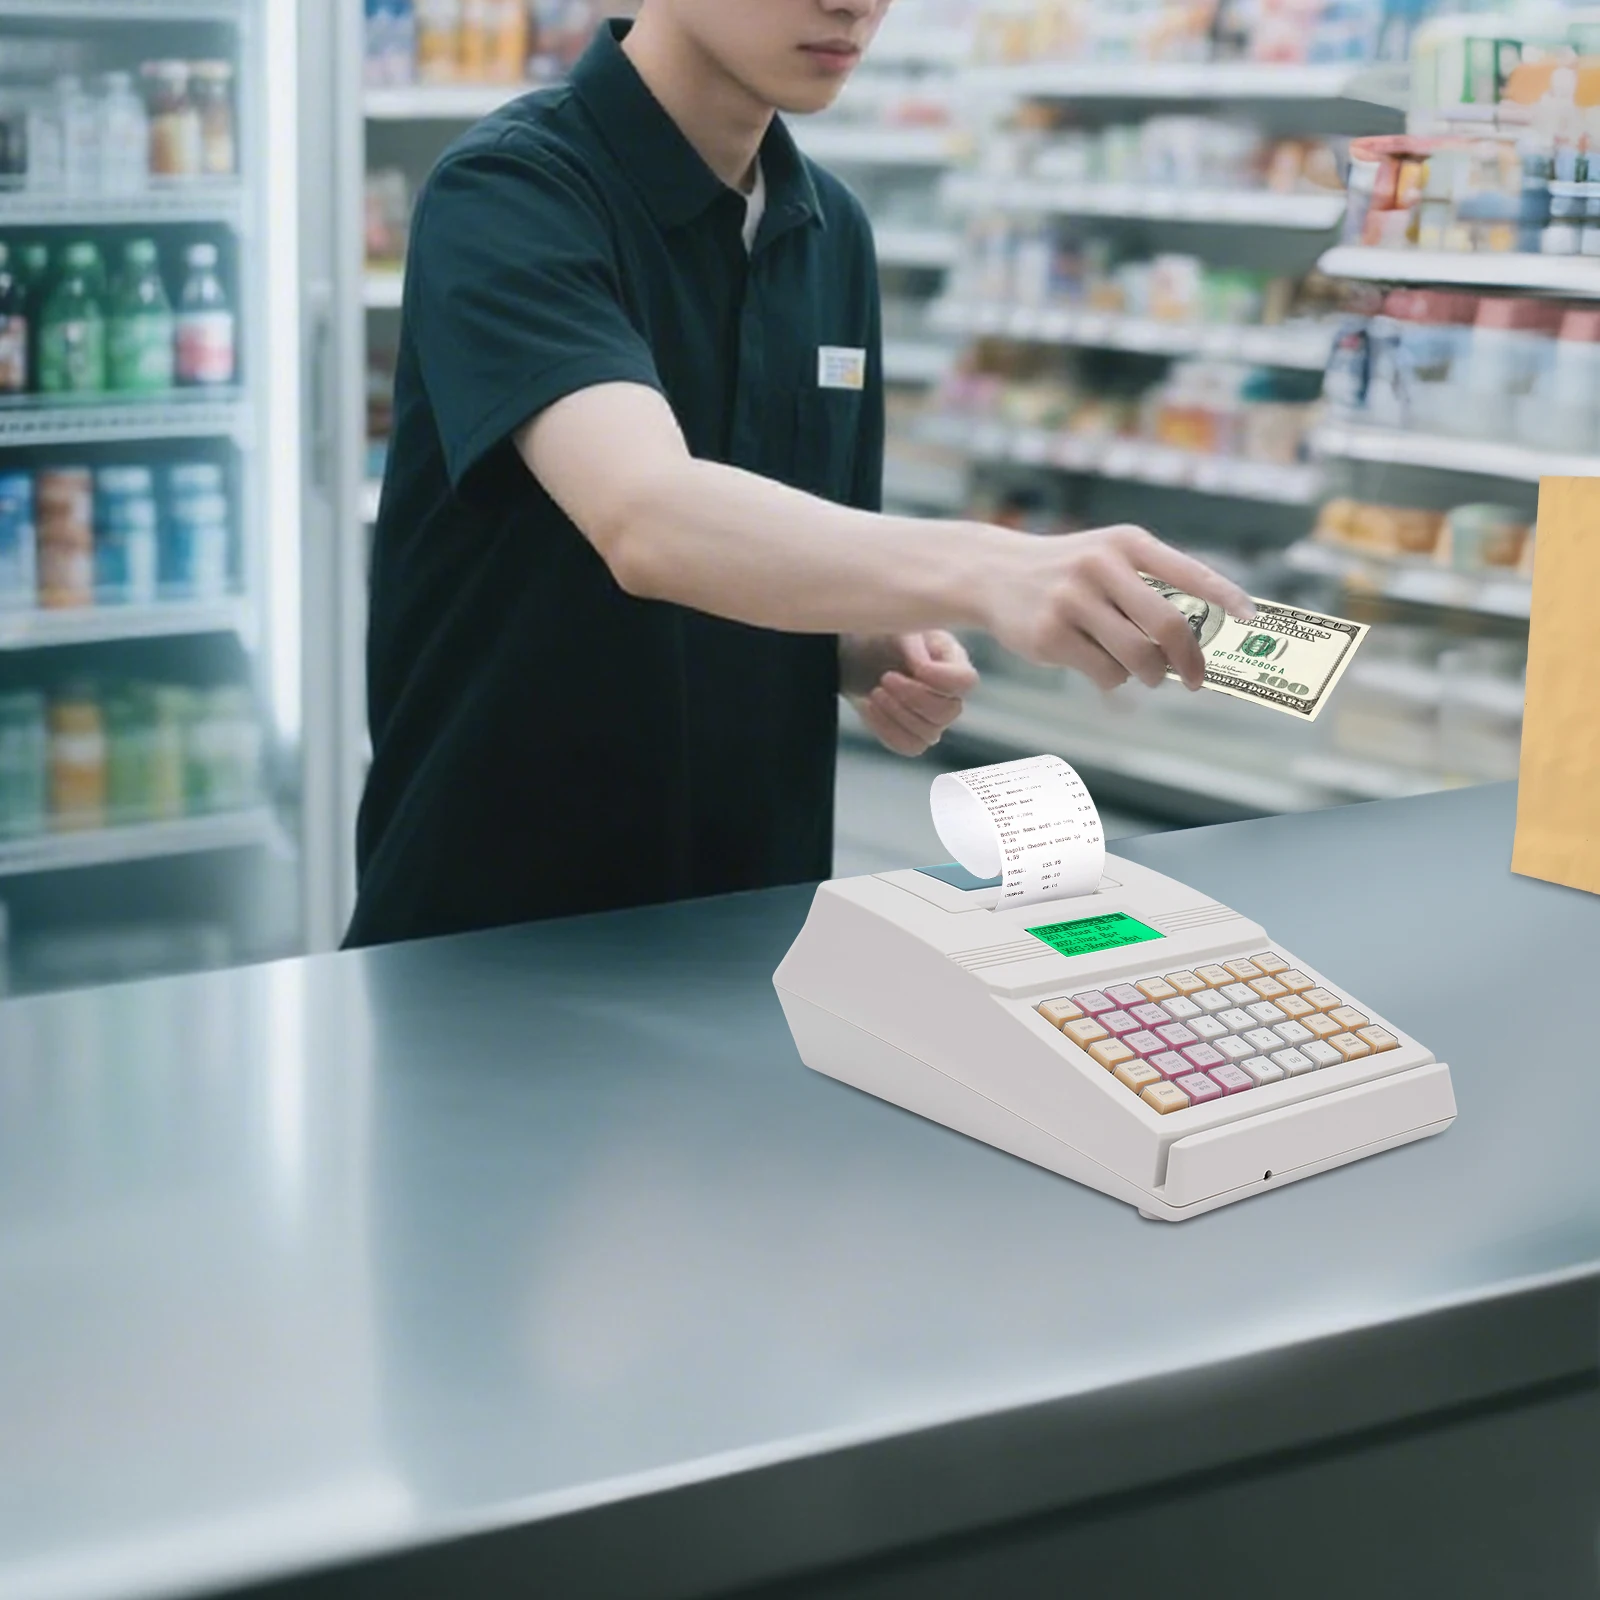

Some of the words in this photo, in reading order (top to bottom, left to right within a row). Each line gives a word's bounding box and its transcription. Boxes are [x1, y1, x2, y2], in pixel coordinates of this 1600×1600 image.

[1212, 650, 1227, 658] DF
[1226, 653, 1279, 673] 07142806
[1205, 673, 1250, 688] NDRED
[1249, 683, 1308, 709] DOLLARS
[1253, 672, 1310, 697] 100
